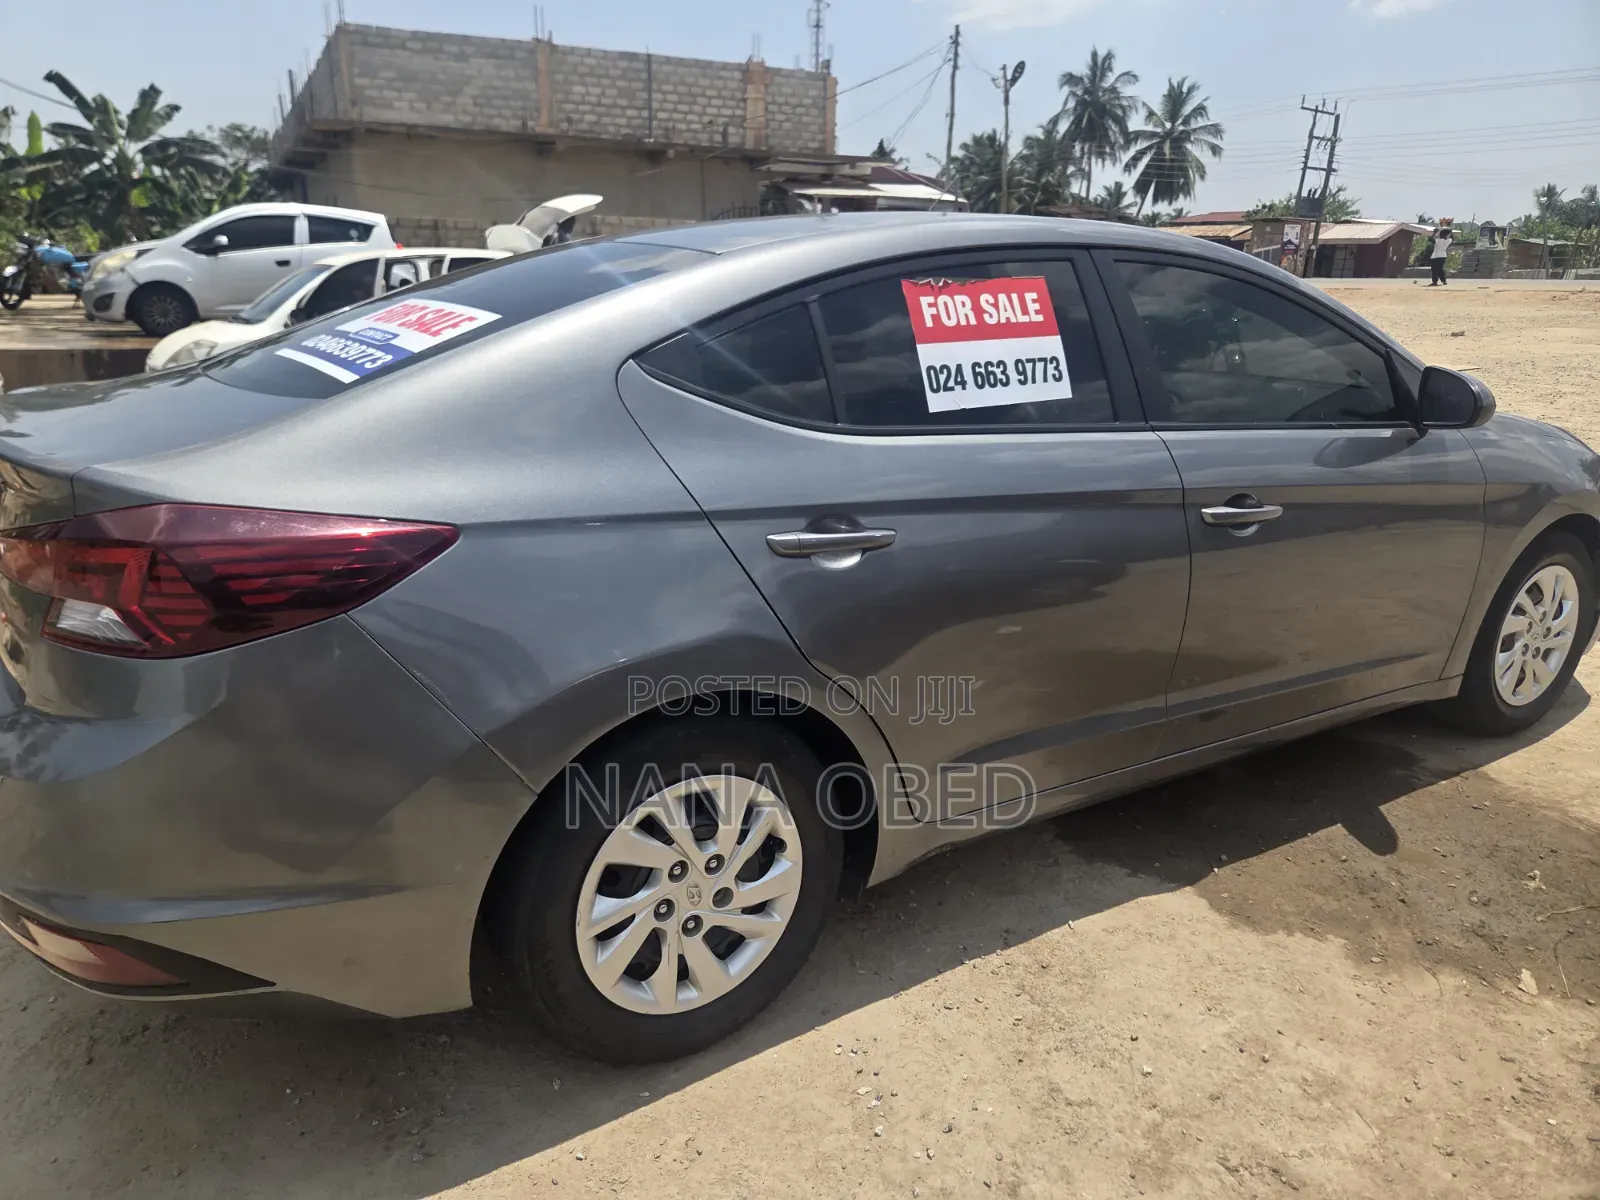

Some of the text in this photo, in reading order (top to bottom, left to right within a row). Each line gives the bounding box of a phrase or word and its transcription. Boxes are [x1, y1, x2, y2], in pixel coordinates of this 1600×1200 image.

[364, 303, 479, 338] FOR SALE
[919, 292, 1045, 328] FOR SALE
[301, 333, 394, 370] 0246639773
[925, 355, 1064, 394] 024 663 9773
